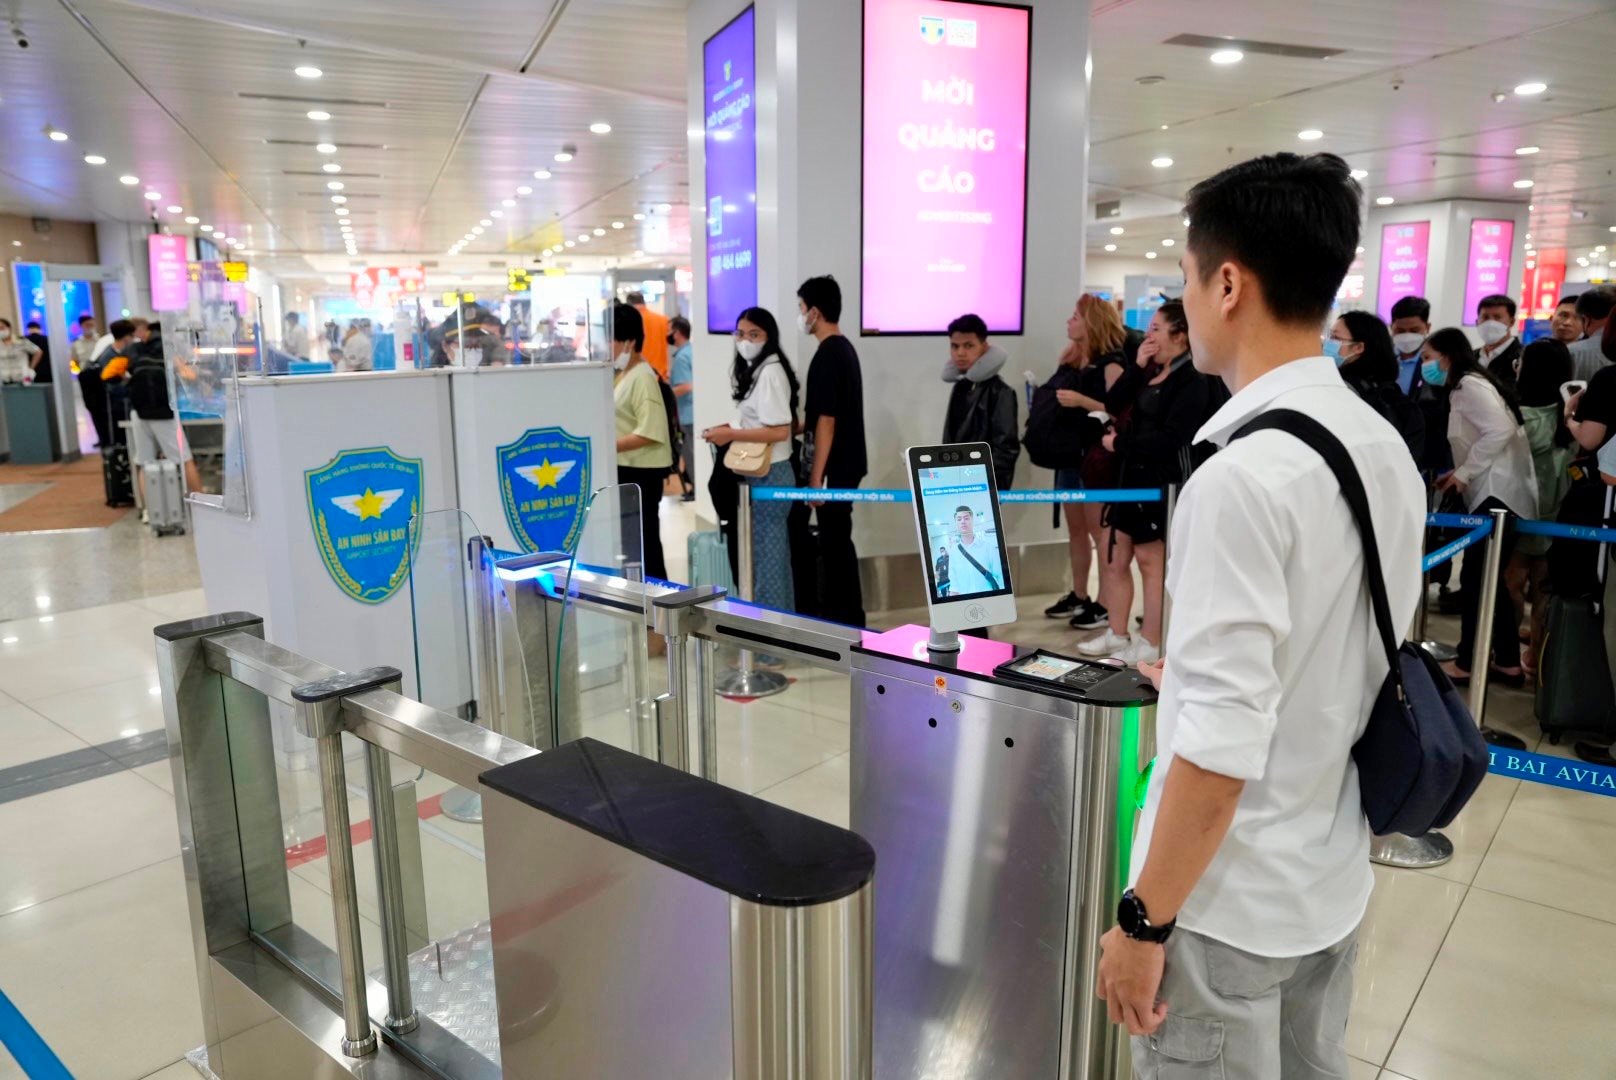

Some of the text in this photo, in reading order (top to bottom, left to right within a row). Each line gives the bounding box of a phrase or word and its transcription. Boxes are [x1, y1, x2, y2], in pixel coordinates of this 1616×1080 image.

[921, 75, 974, 105] MỜI
[898, 118, 995, 152] QUẢNG
[917, 164, 975, 193] CÁO
[337, 537, 349, 550] AN
[351, 534, 372, 548] NINH
[390, 527, 406, 542] BAY
[1506, 755, 1547, 776] BAI
[1555, 766, 1616, 789] AVIA
